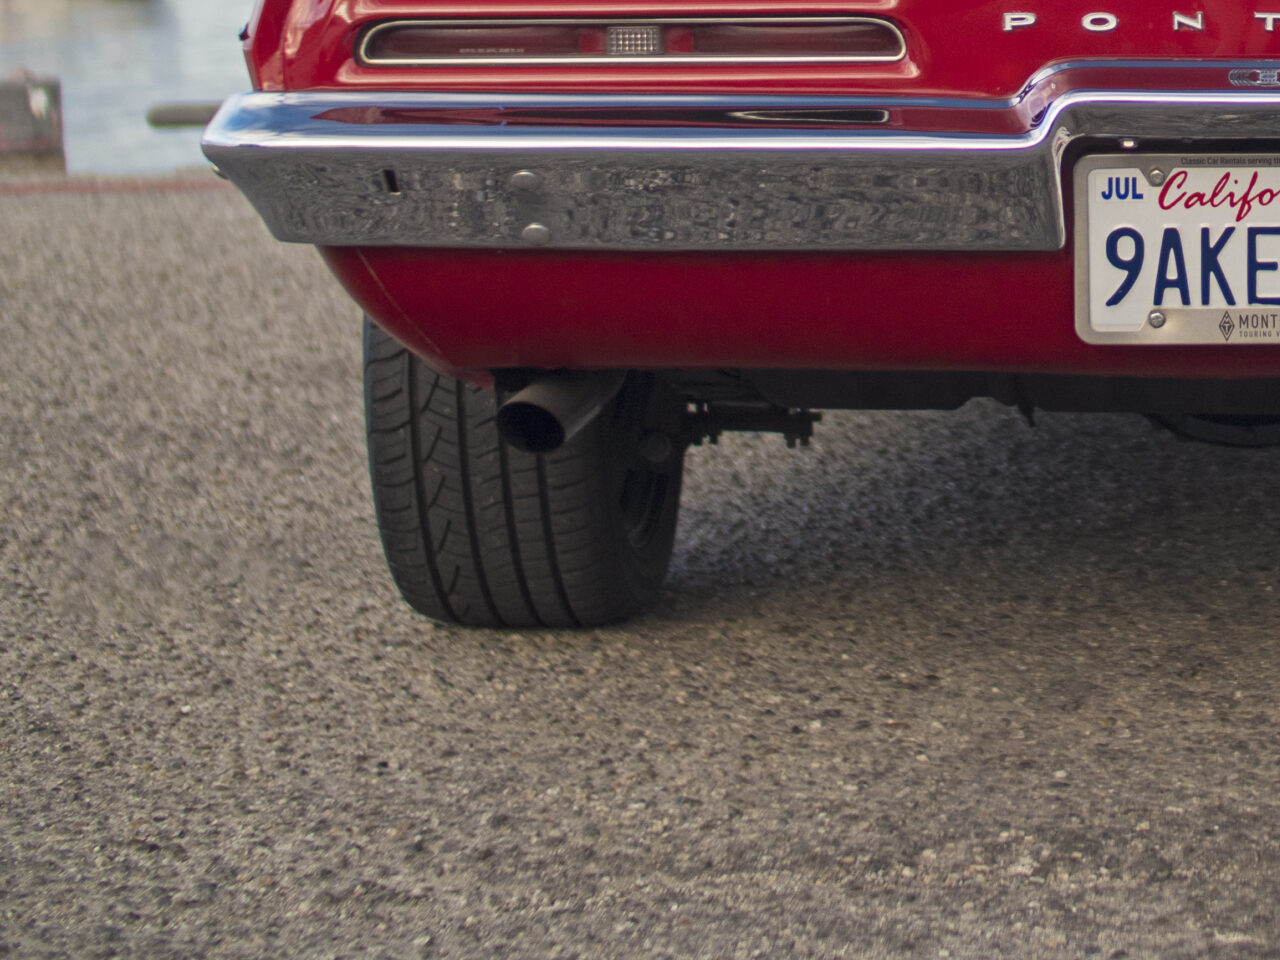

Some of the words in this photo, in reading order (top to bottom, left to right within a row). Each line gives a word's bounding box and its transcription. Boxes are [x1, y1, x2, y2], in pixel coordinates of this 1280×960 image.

[1181, 156, 1206, 165] Classic
[1207, 156, 1219, 165] Car
[1220, 156, 1247, 165] Rentals
[1248, 157, 1273, 166] serving
[1101, 177, 1144, 200] JUL
[1239, 330, 1272, 338] TOURING
